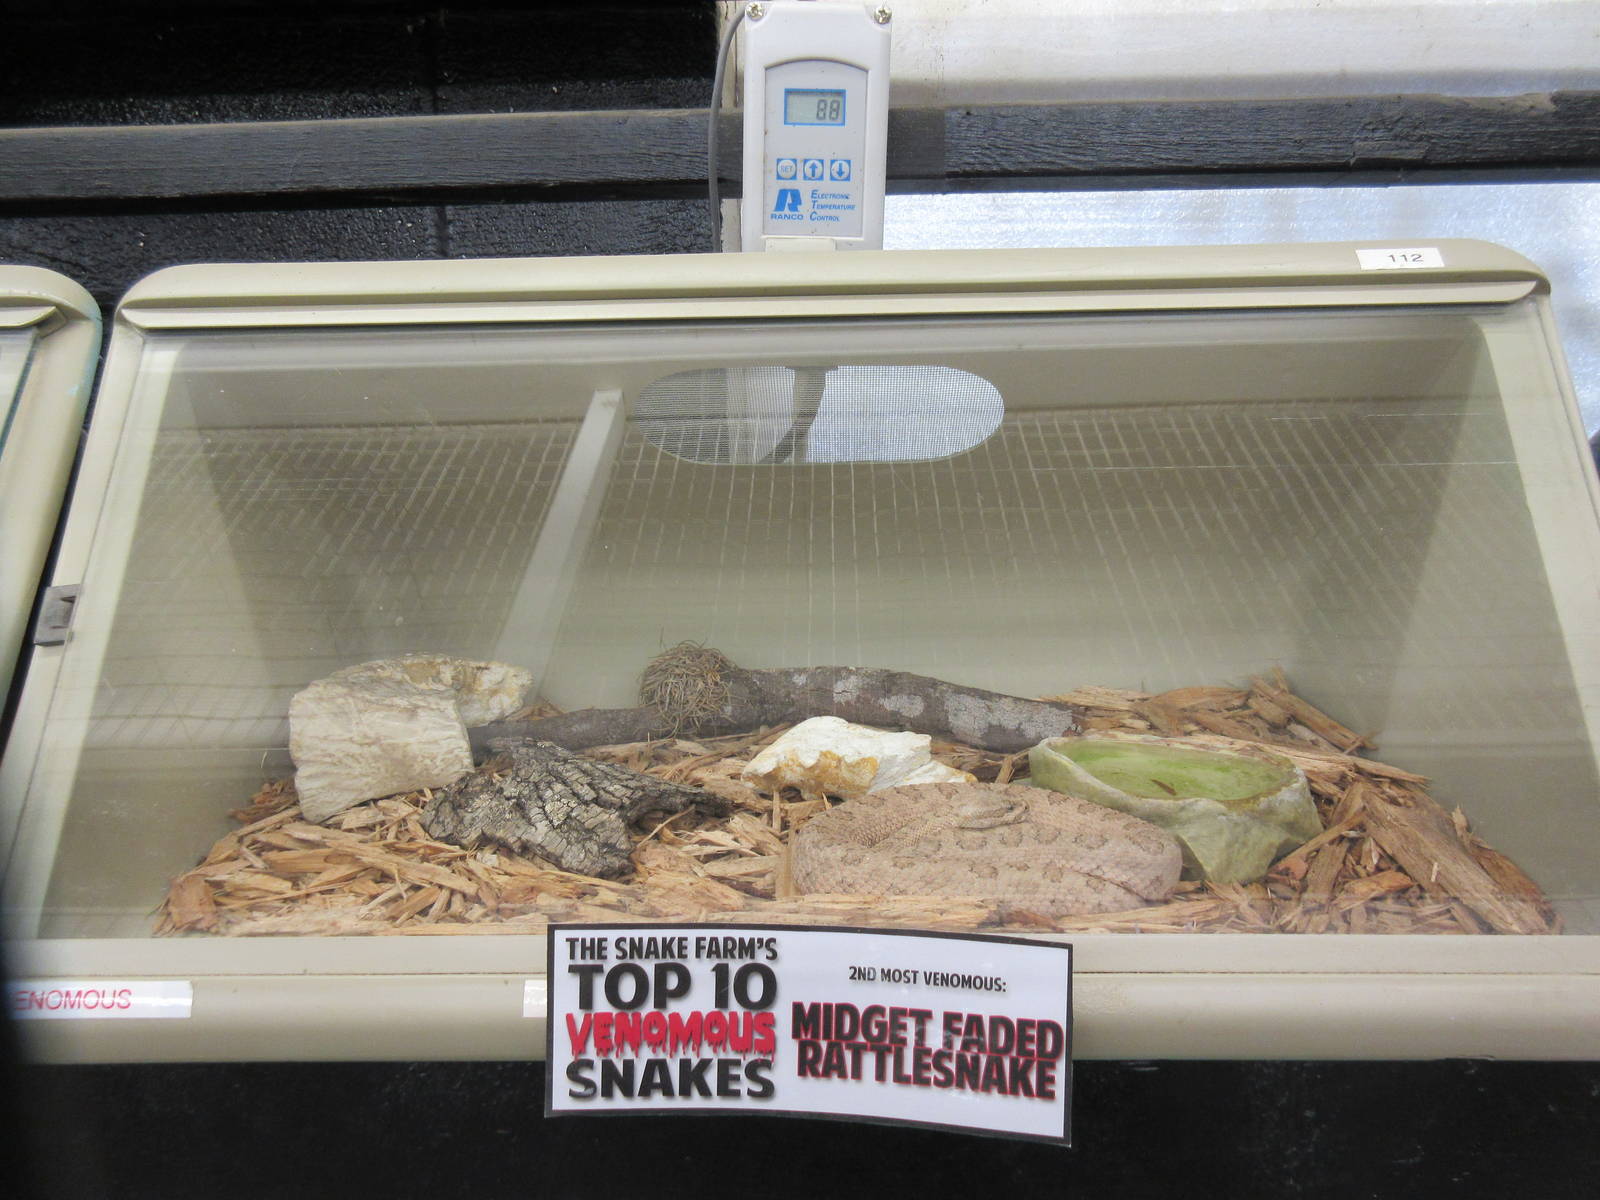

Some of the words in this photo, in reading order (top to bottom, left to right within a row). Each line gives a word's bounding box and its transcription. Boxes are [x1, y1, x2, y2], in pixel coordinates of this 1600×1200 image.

[816, 99, 840, 120] 88
[780, 165, 793, 173] SET
[809, 211, 840, 222] CONTROL
[811, 200, 855, 211] TEMPERATURE
[1388, 253, 1424, 263] 112
[565, 937, 608, 960] THE
[615, 937, 688, 960] SNAKE
[695, 937, 778, 960] FARM'S
[568, 962, 692, 1010] TOP
[711, 962, 778, 1010] 10
[849, 966, 877, 982] 2ND
[881, 968, 919, 985] MOST
[923, 971, 1007, 992] VENOMOUS:
[14, 989, 132, 1010] ENOMOUS
[565, 1011, 776, 1062] VENOMOUS
[791, 1001, 933, 1048] MIDGET
[942, 1010, 1065, 1061] FADED
[566, 1058, 775, 1098] SNAKES
[797, 1039, 1056, 1100] RATTLESNAKE
